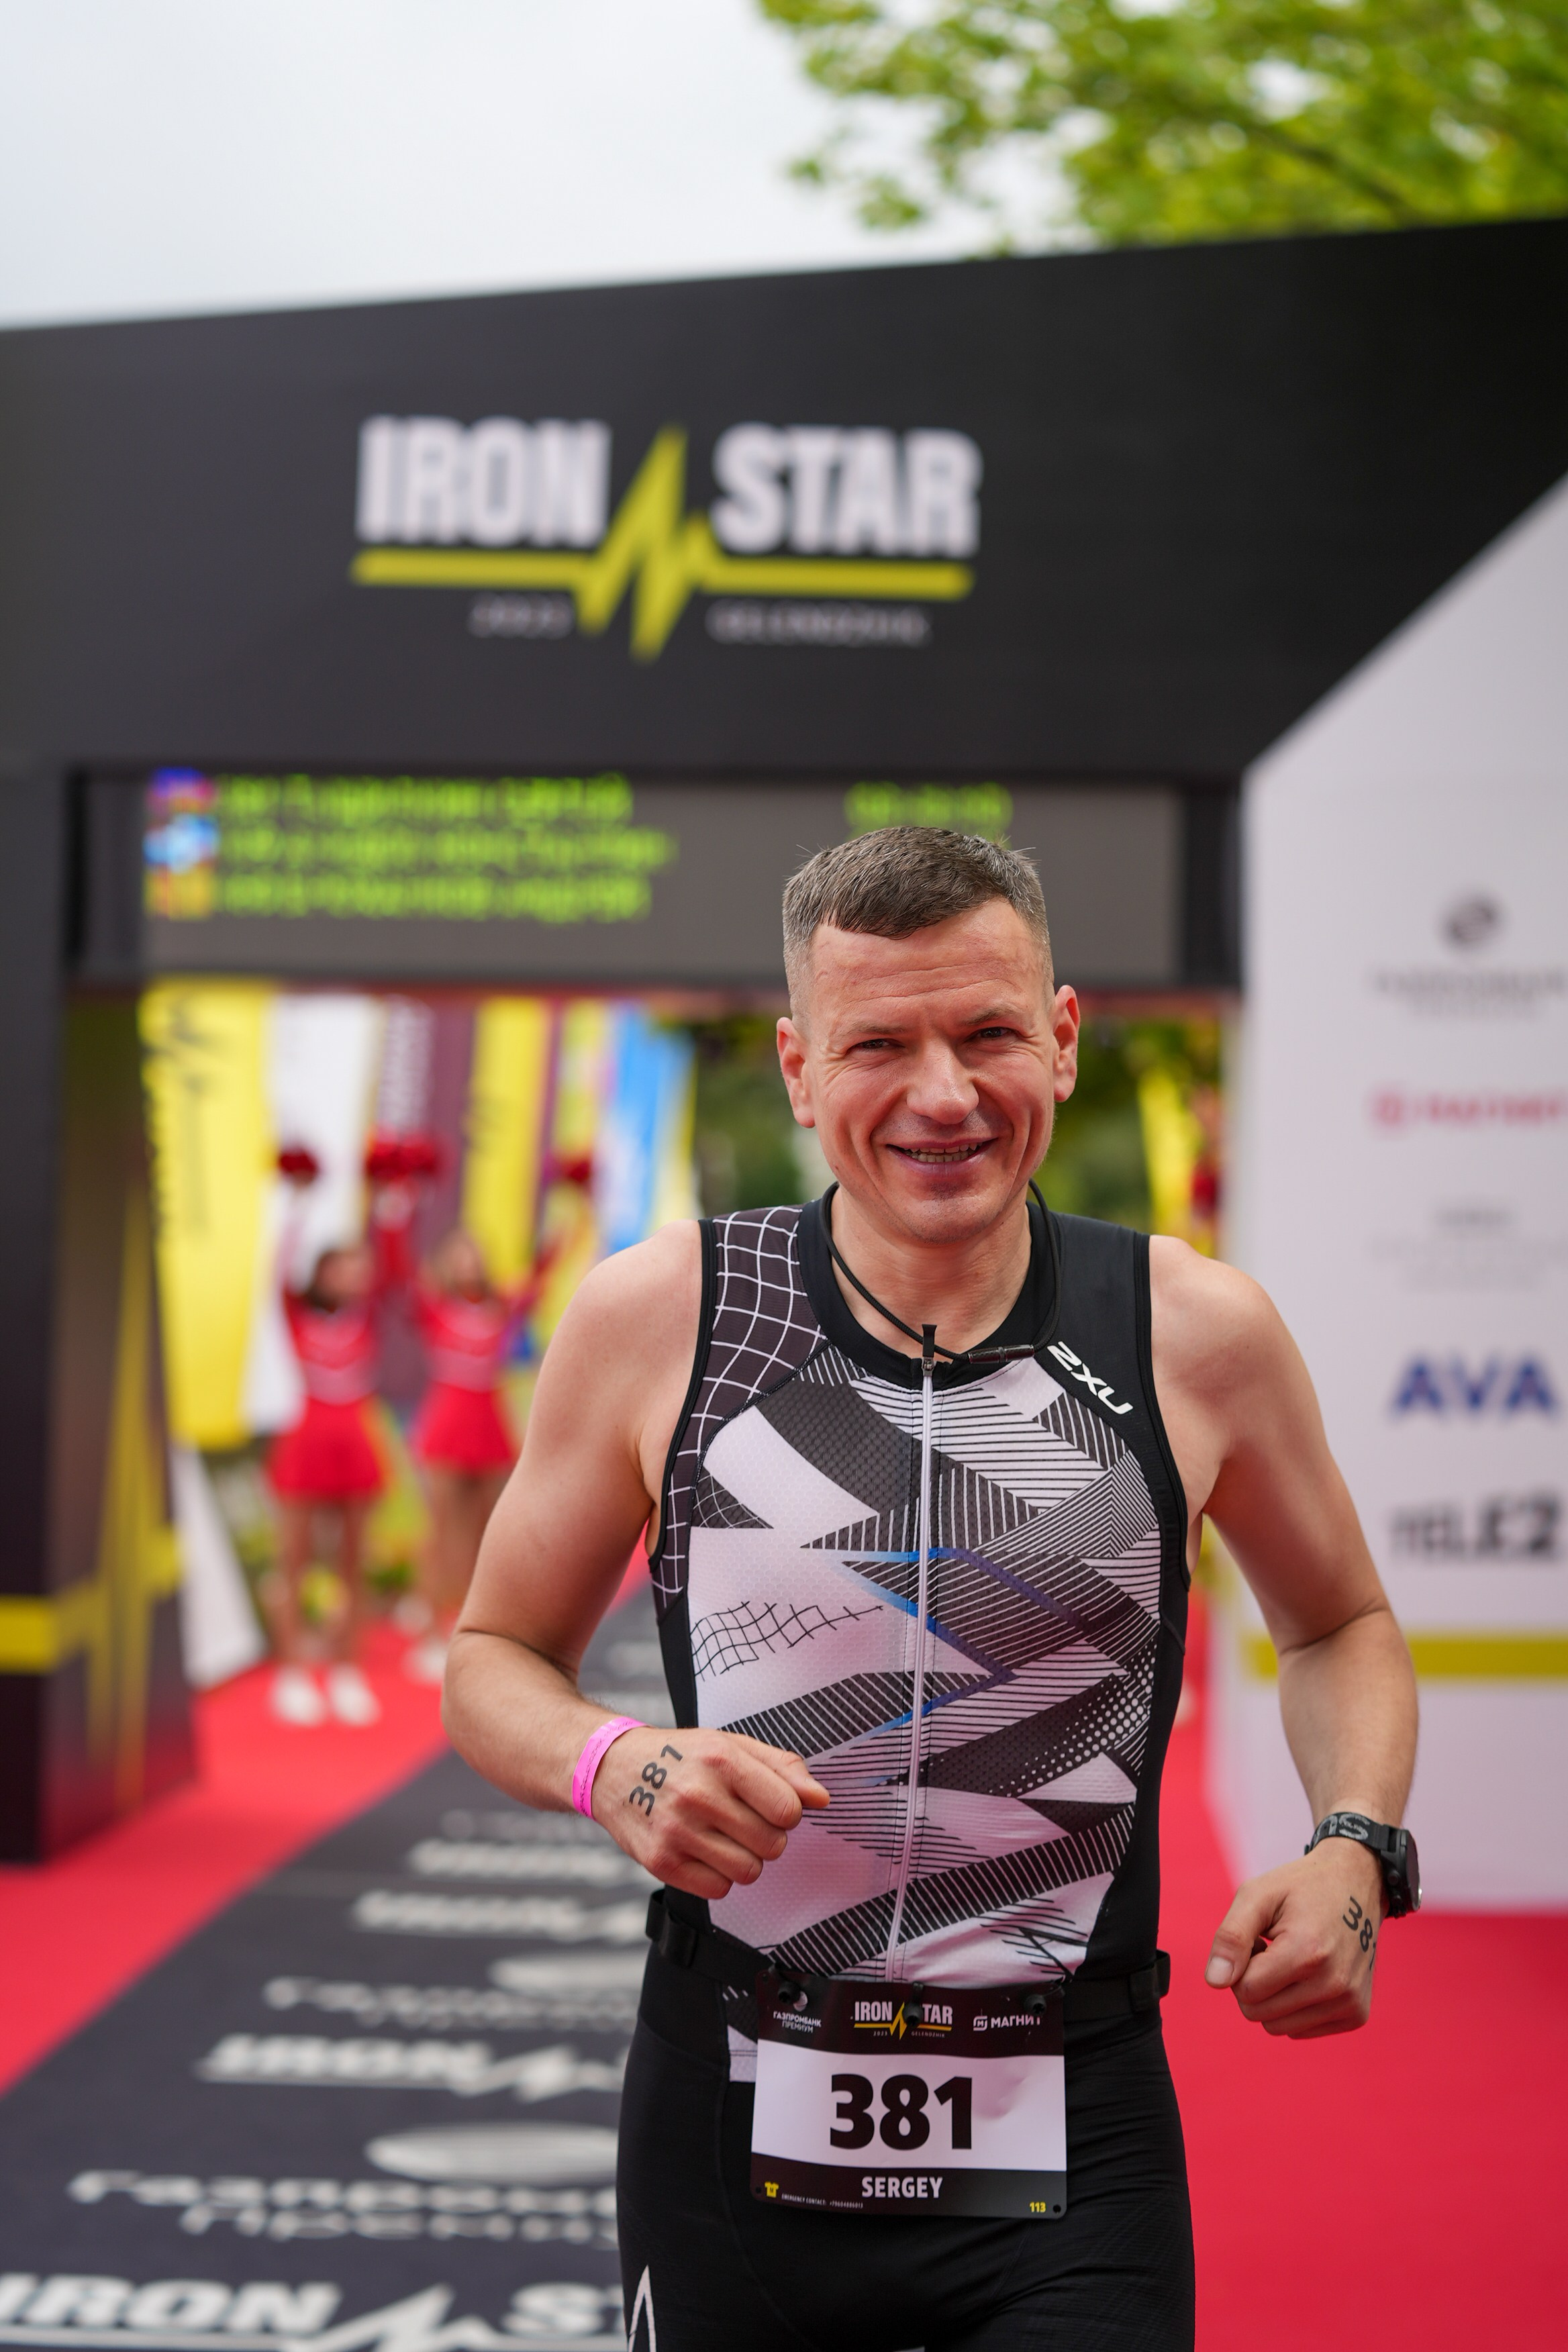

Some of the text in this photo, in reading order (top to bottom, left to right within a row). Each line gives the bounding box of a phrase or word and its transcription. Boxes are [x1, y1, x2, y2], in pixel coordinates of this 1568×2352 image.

[358, 416, 984, 557] IRON STAR
[1388, 1353, 1559, 1423] AVA
[629, 1745, 683, 1817] 381
[773, 2011, 822, 2027] ГАЗПРОМБАНК
[854, 2001, 953, 2025] IRON TAR
[830, 2073, 973, 2150] 381
[861, 2176, 943, 2198] SERGEY
[1029, 2202, 1046, 2213] 113
[0, 2274, 339, 2333] IRON
